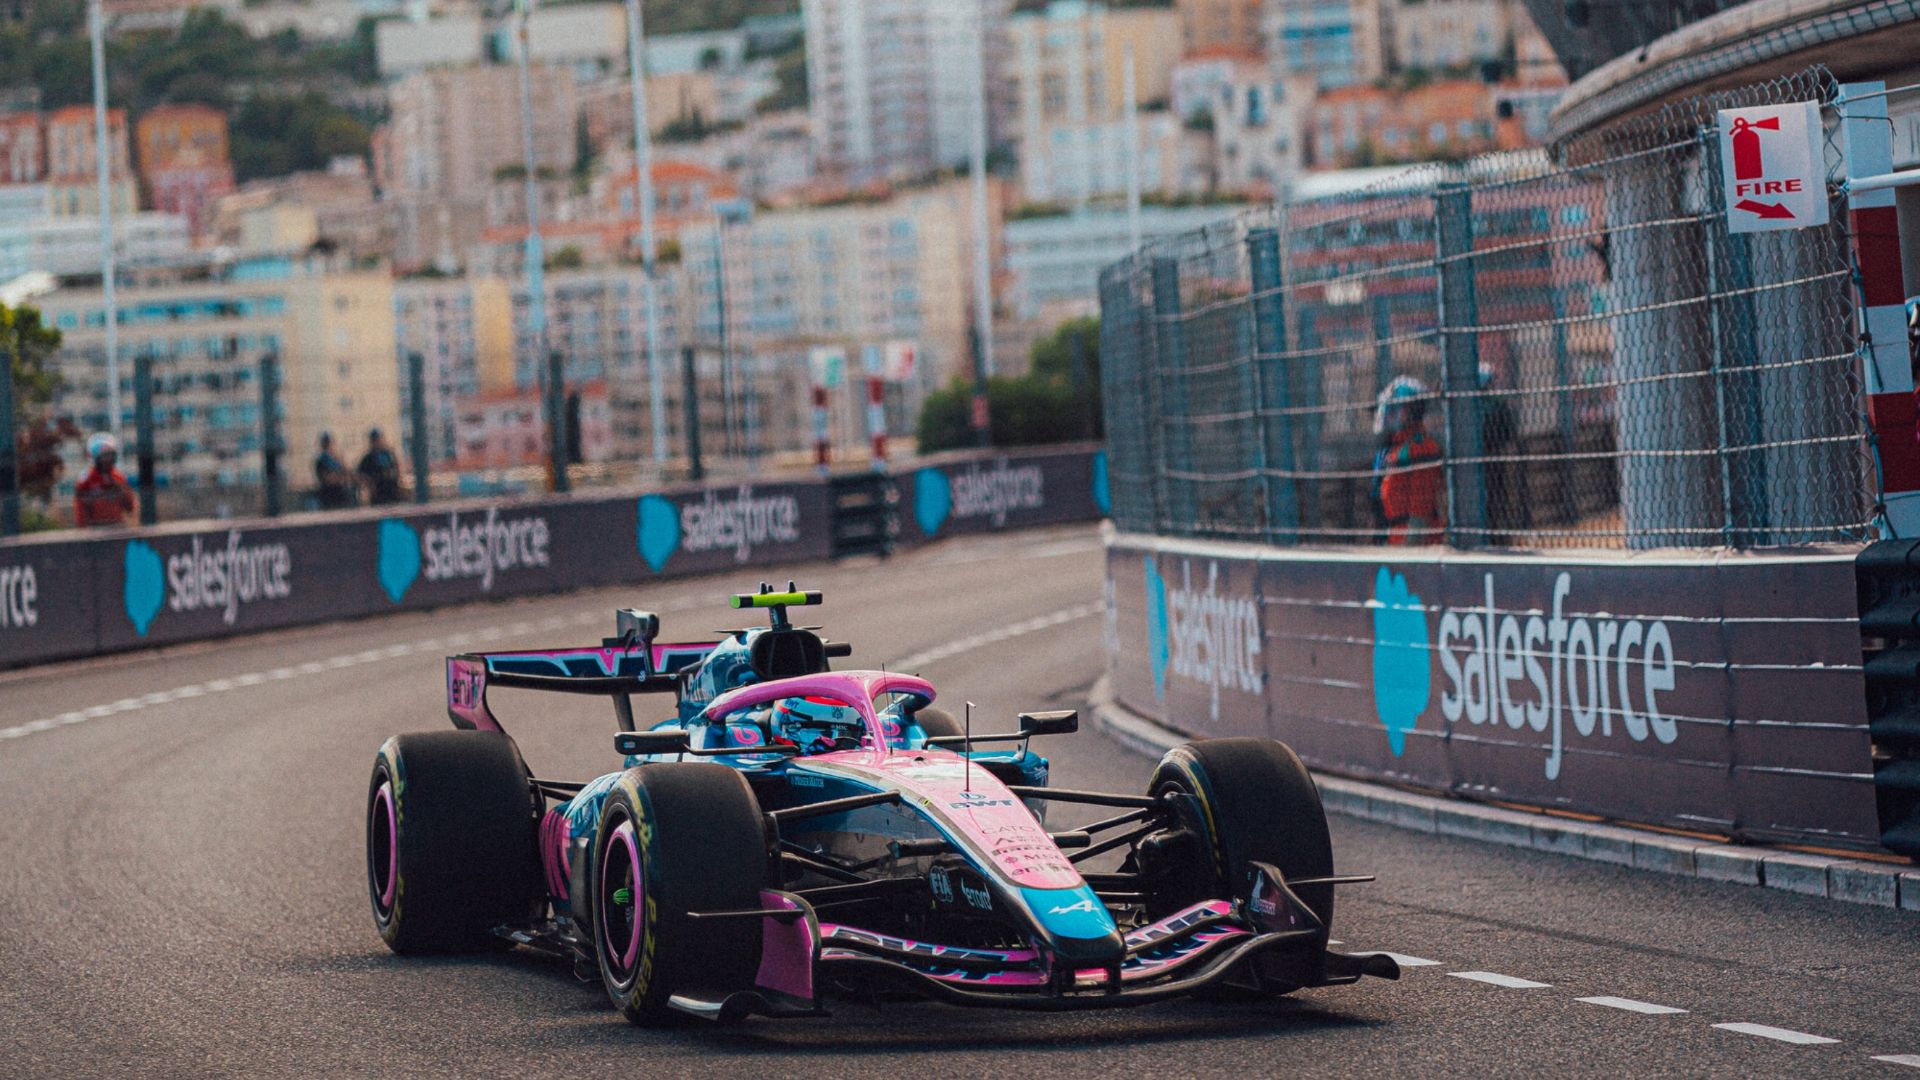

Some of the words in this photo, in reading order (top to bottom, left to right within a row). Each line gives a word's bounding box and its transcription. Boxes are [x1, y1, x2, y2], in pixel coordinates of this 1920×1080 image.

[1736, 179, 1802, 196] FIRE
[424, 507, 549, 590] salesforce
[682, 484, 799, 562] salesforce
[167, 529, 291, 624] salesforce
[1170, 559, 1263, 720] salesforce
[1439, 572, 1678, 780] salesforce
